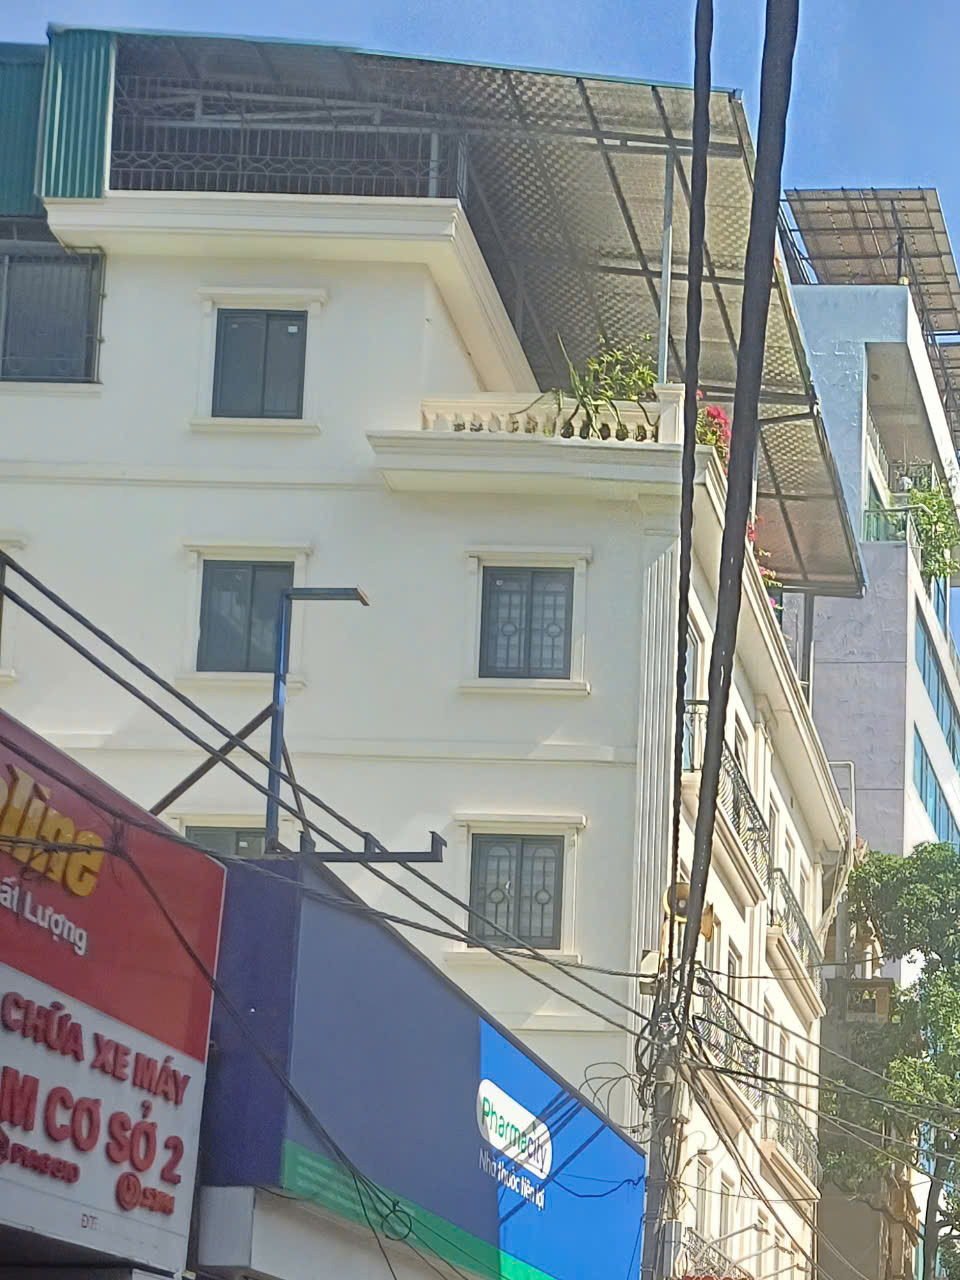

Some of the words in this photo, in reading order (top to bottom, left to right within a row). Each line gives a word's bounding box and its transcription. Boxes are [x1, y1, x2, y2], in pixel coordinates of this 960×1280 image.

[24, 891, 88, 956] Lượng
[91, 1032, 131, 1081] XE
[132, 1056, 191, 1106] MÁY
[44, 1086, 102, 1152] CƠ
[106, 1100, 157, 1172] SỞ
[160, 1135, 184, 1185] 2
[482, 1096, 547, 1173] Pharmacity
